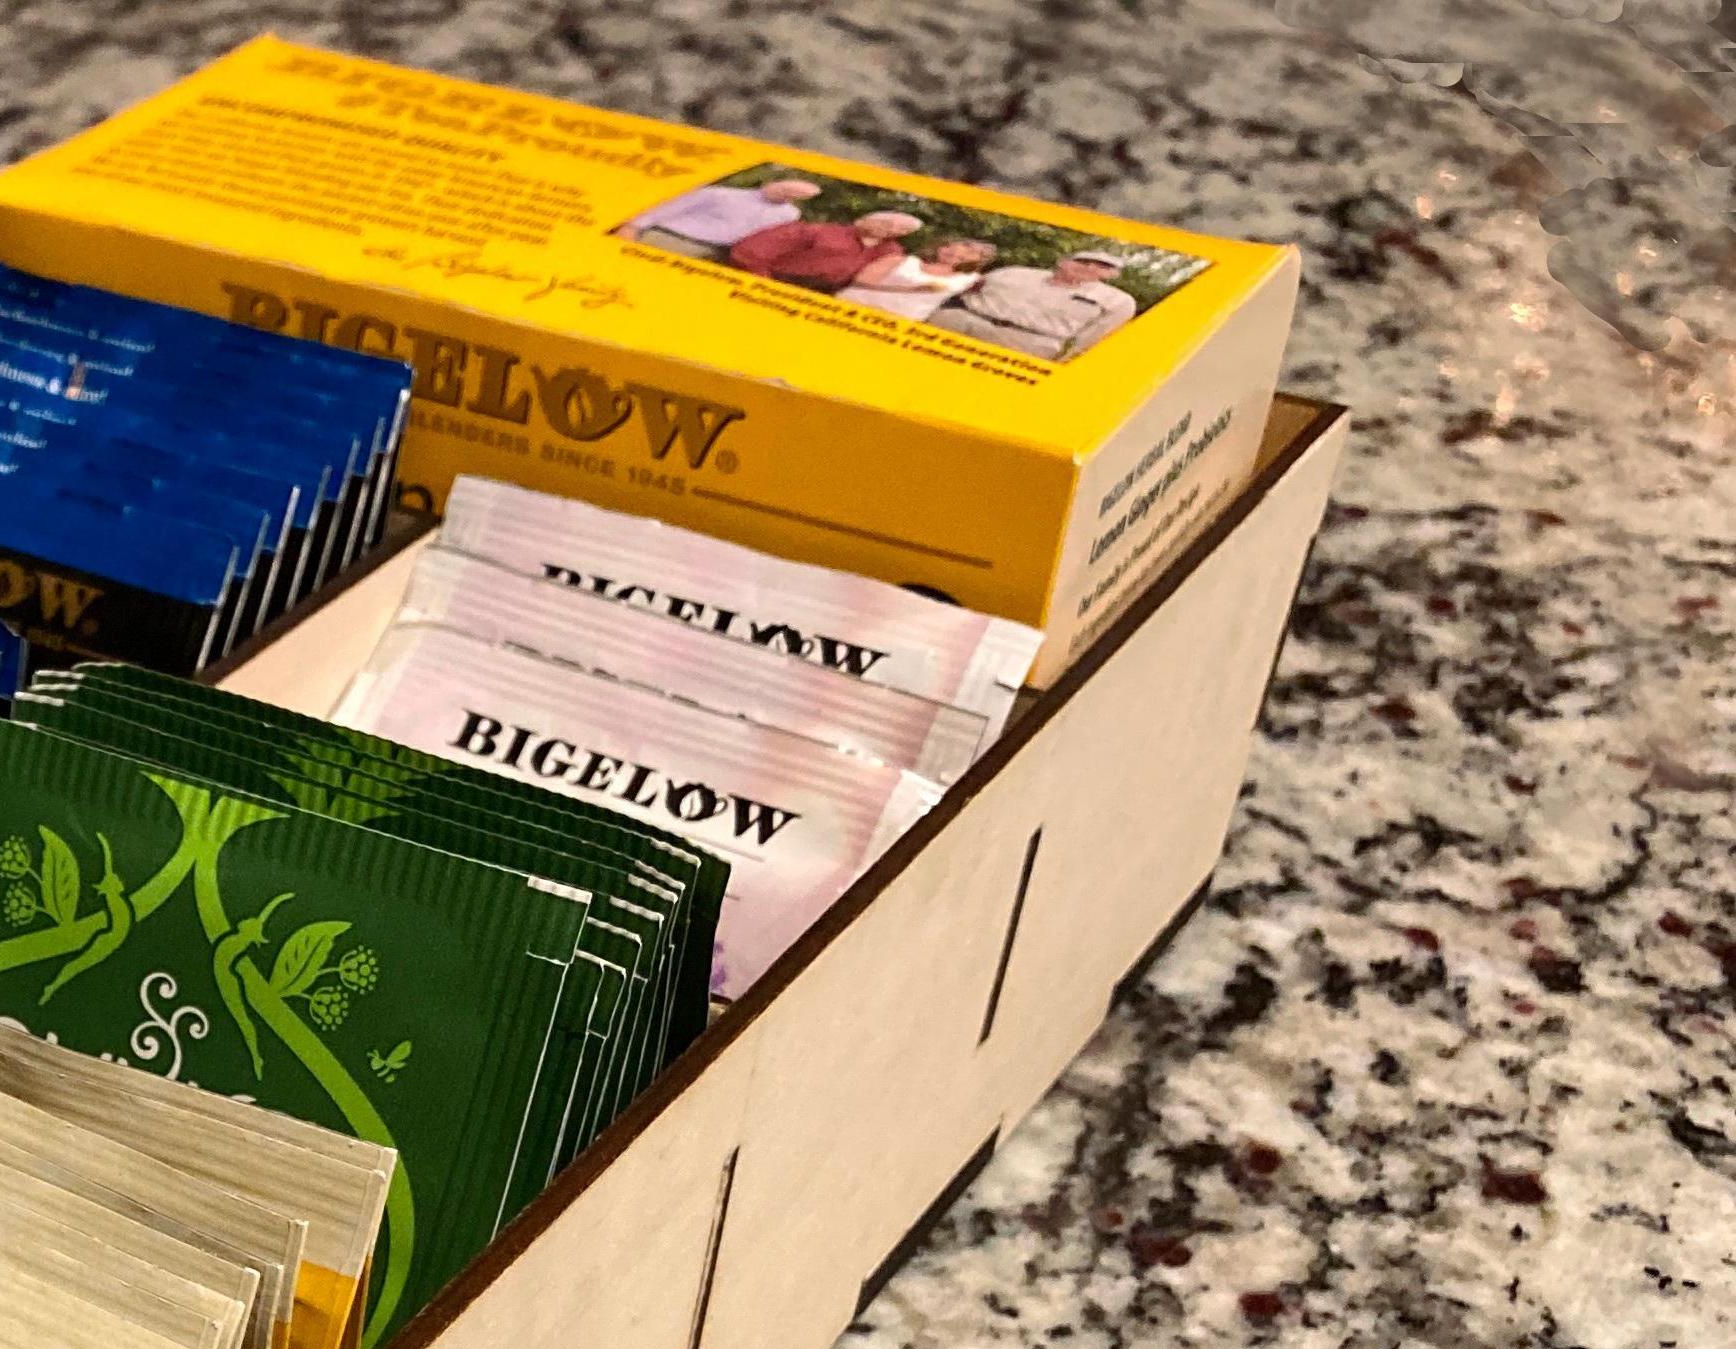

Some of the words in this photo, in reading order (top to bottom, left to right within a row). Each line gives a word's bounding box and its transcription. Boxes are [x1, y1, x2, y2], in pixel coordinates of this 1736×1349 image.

[902, 339, 966, 363] Lemon
[941, 338, 1052, 376] Generation
[446, 707, 801, 848] BIGELOW
